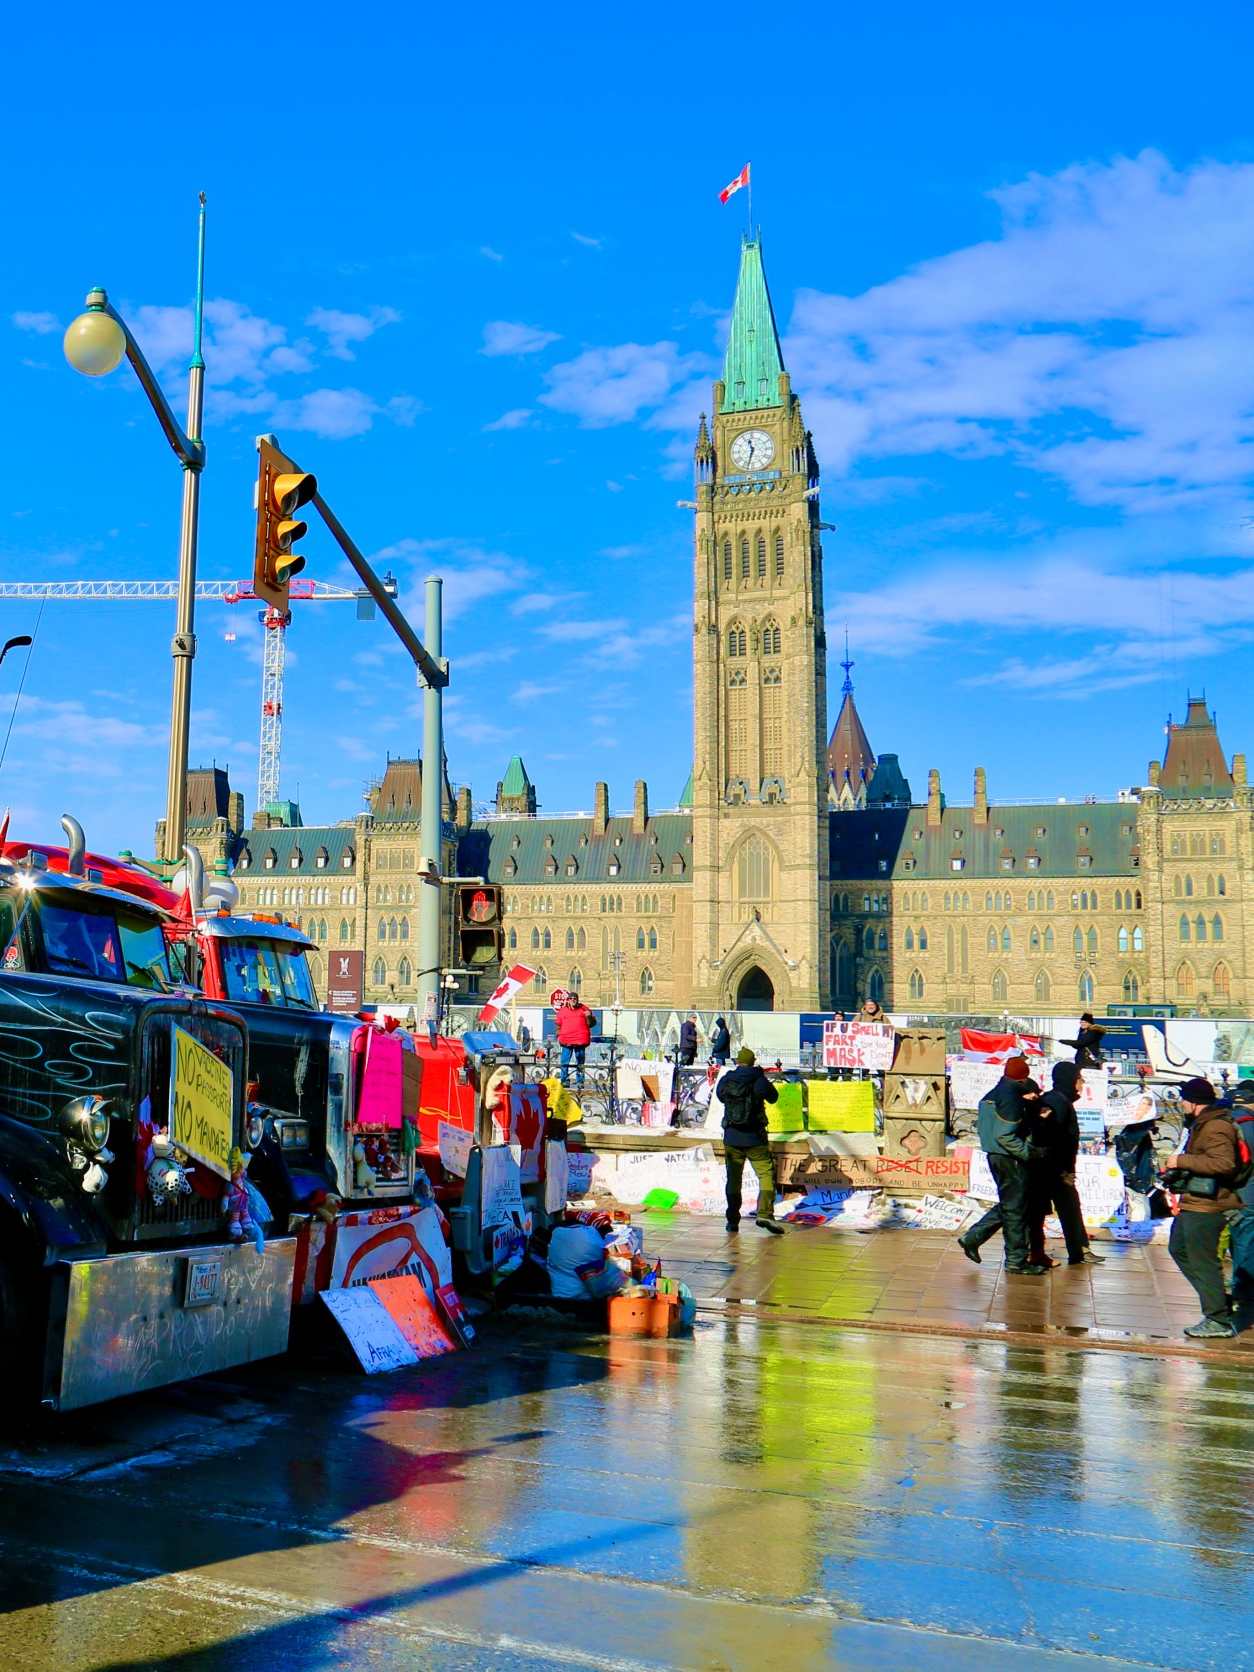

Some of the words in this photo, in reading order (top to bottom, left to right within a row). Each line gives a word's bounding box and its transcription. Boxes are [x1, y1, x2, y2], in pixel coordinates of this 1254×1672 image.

[825, 1022, 837, 1033] IF
[840, 1022, 849, 1034] U
[177, 1038, 196, 1087] NO
[193, 1041, 228, 1090] VACCINE
[826, 1048, 865, 1067] MASK
[174, 1092, 193, 1141] NO
[196, 1115, 231, 1162] MANDATES
[782, 1157, 806, 1173] THE
[815, 1158, 868, 1173] GREAT
[779, 1175, 799, 1184] THEY
[889, 1179, 905, 1187] AND
[912, 1180, 923, 1188] BE
[928, 1181, 965, 1189] UNHAPPY
[924, 1196, 969, 1216] WELCOME
[912, 1214, 942, 1226] LOVE
